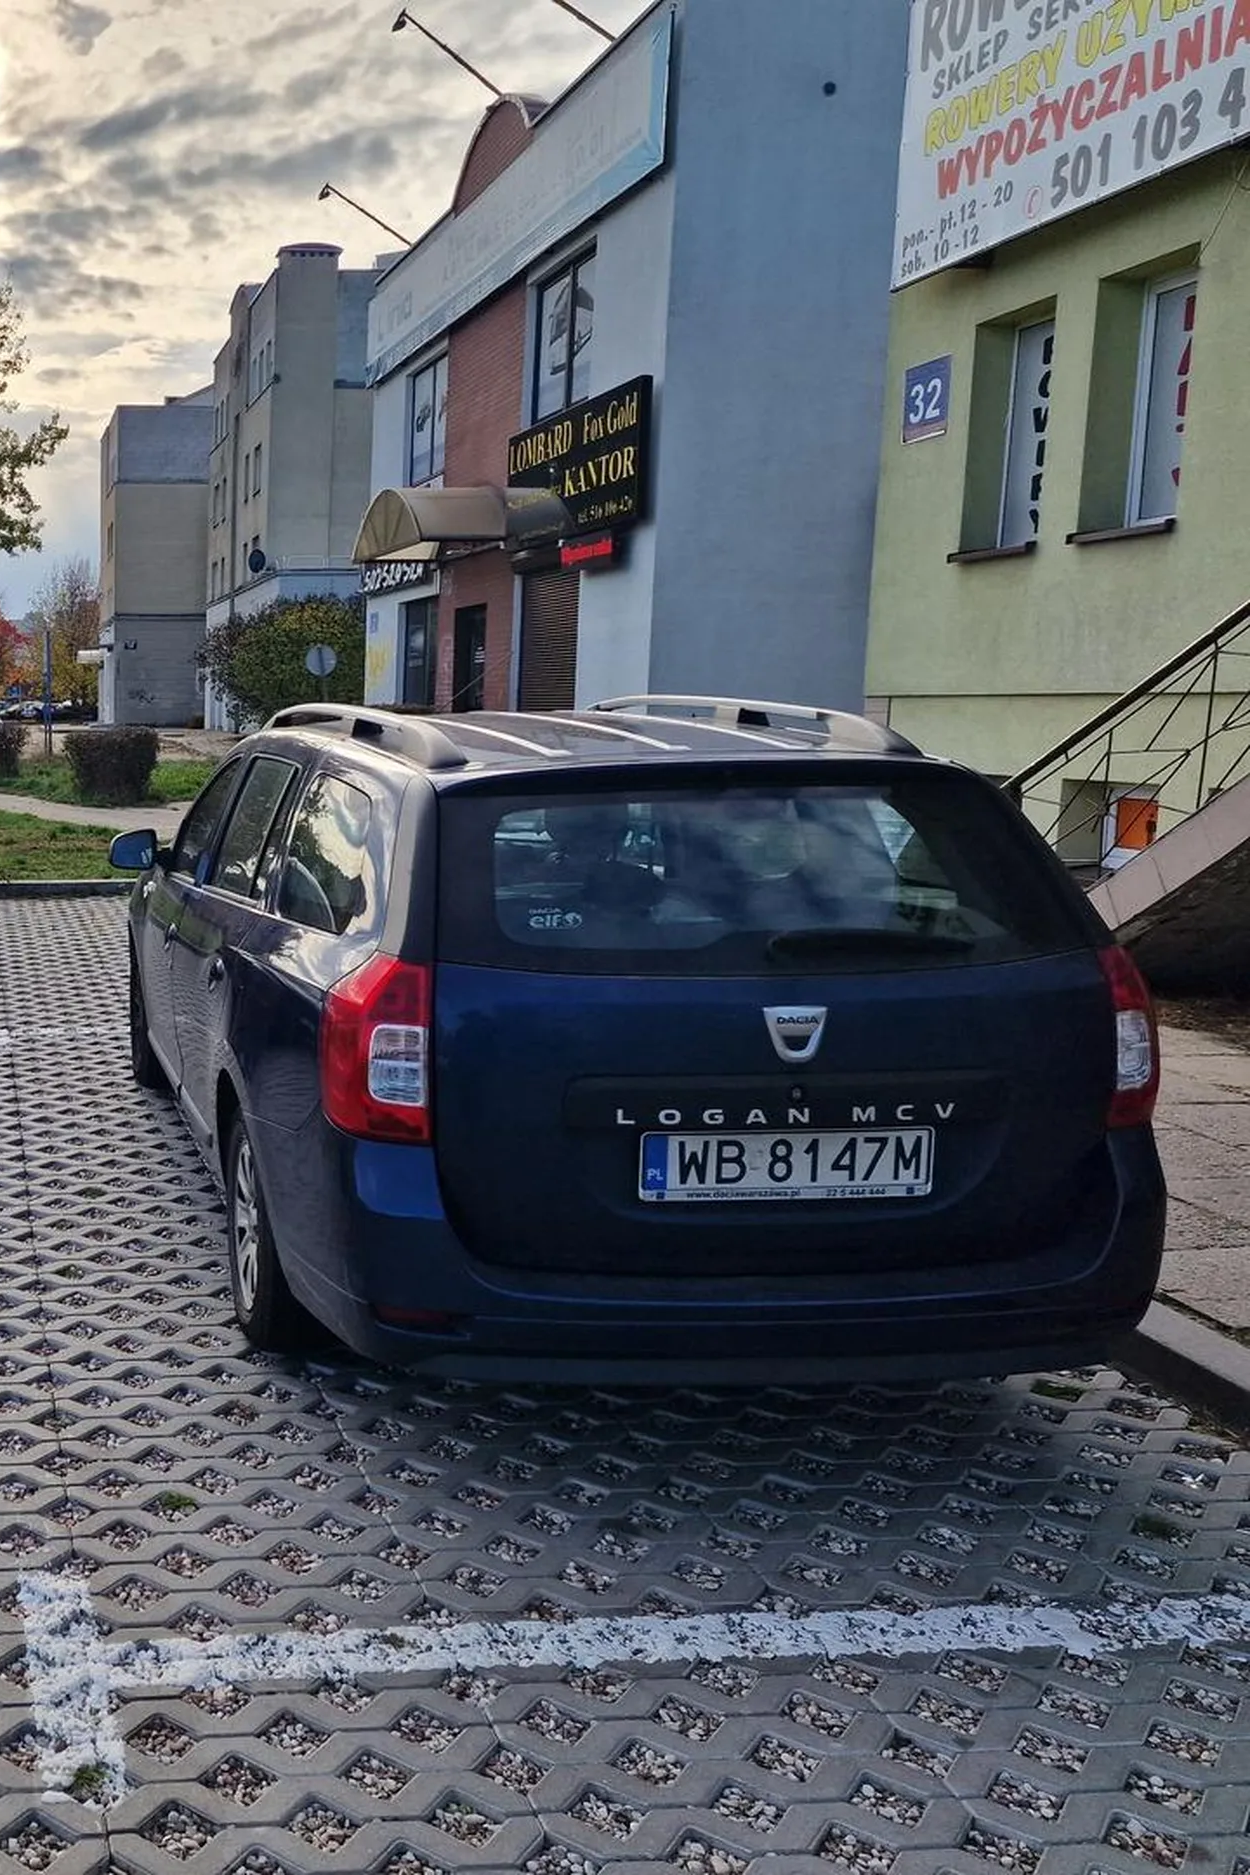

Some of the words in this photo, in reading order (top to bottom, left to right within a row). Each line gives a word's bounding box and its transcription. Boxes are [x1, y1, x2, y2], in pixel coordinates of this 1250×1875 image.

[932, 29, 1009, 99] SKLEP
[924, 29, 1067, 157] ROWERY
[937, 0, 1250, 199] WYPOŻYCZALNIA
[1051, 133, 1112, 208] 501
[1132, 88, 1204, 171] 103
[993, 180, 1014, 208] 20
[909, 377, 942, 424] 32
[509, 420, 573, 476] LOMBARD
[606, 391, 639, 435] Gold
[563, 446, 636, 498] KANTOR
[529, 913, 562, 929] elf
[776, 1015, 820, 1025] DACIA
[616, 1107, 811, 1126] LOGAN
[851, 1102, 956, 1123] MCV
[647, 1167, 665, 1181] PL
[677, 1138, 748, 1186] WB
[766, 1134, 924, 1185] 8147M
